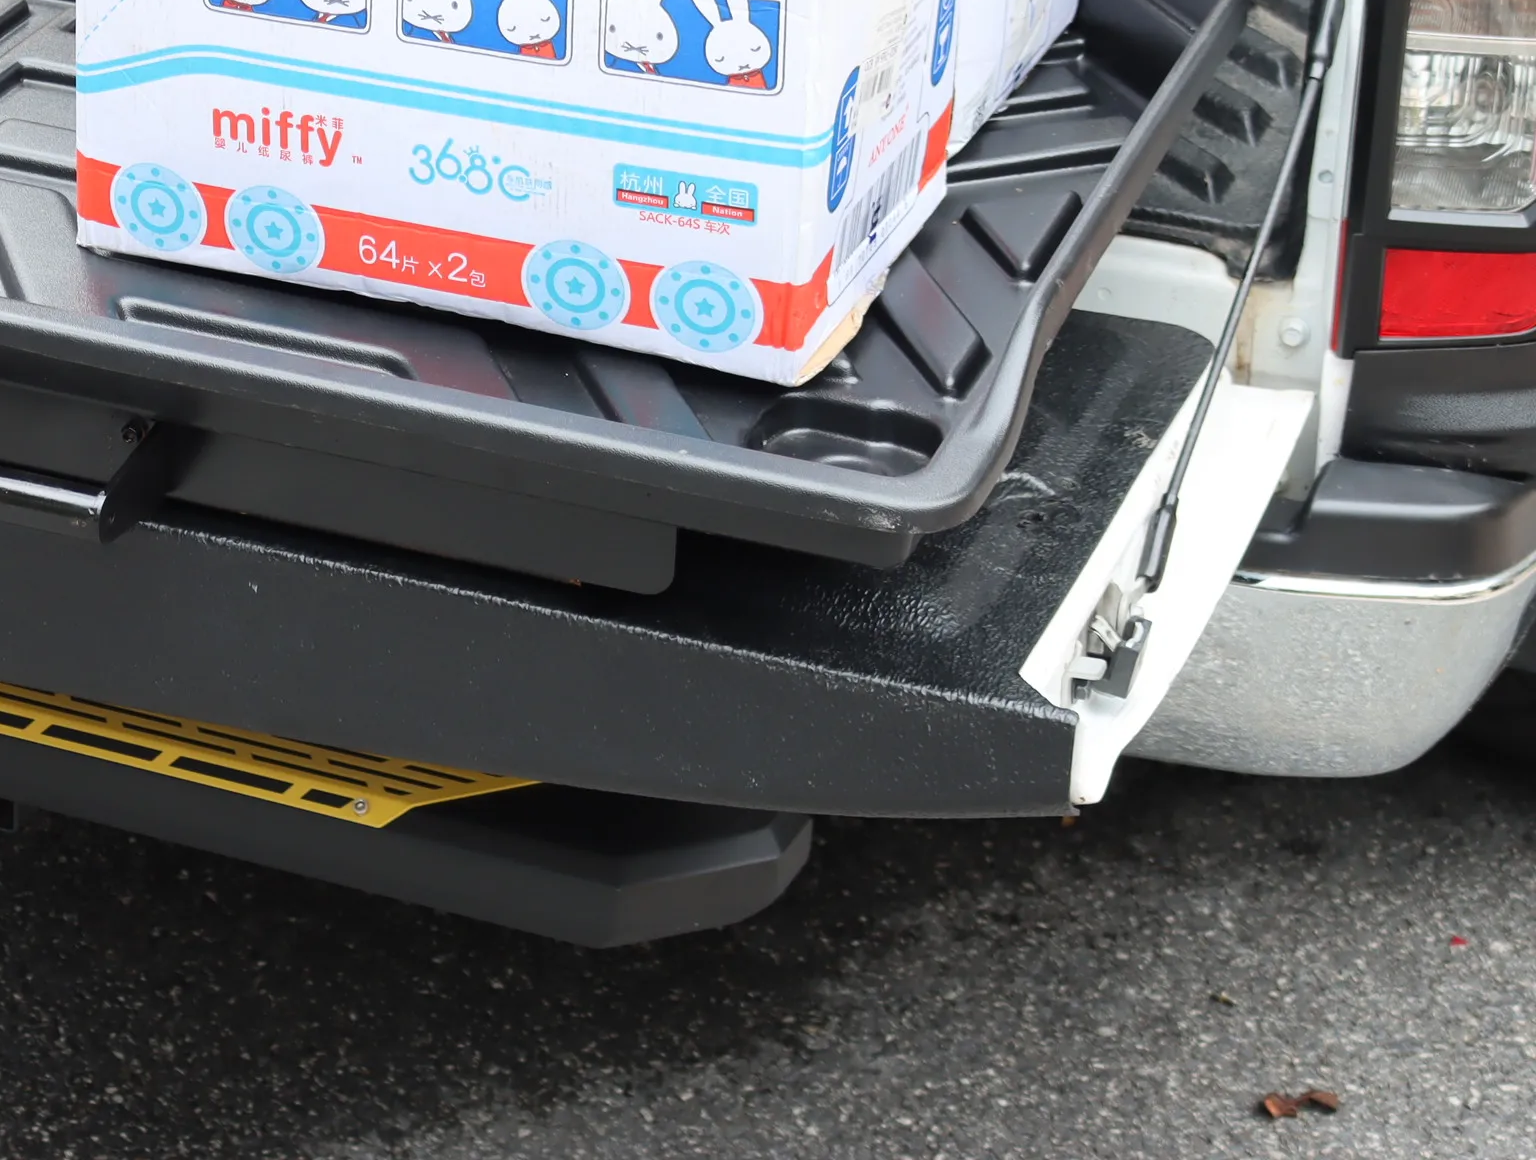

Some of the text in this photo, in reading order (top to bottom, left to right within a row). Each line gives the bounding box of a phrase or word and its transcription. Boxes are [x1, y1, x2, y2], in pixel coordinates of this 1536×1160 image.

[315, 114, 345, 131] 米菲
[212, 107, 343, 168] miffy
[619, 170, 750, 208] 杭州 全国
[621, 192, 744, 218] Hangzhou Nation
[639, 210, 731, 236] SACK-64S 车次
